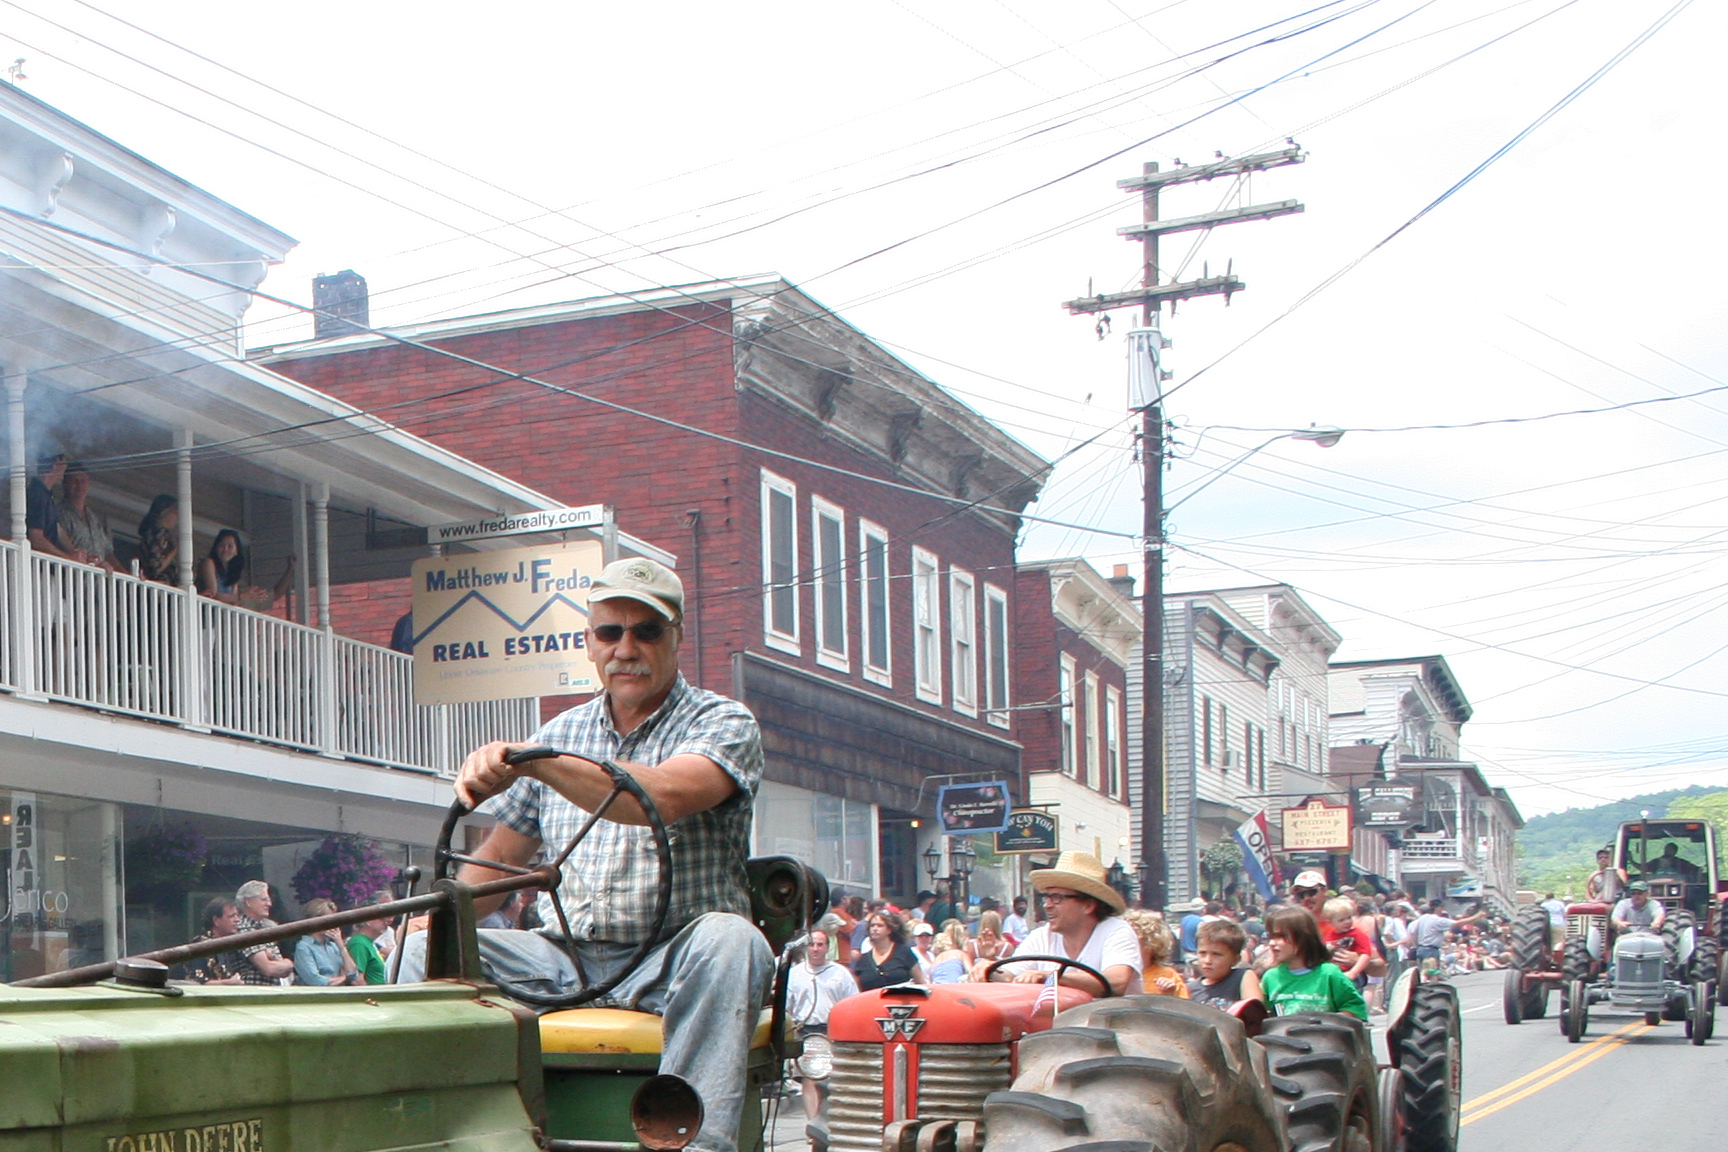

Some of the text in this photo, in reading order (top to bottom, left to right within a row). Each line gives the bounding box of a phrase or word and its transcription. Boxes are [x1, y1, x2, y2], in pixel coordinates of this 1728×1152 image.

[439, 509, 591, 538] www.fredarealty.com
[426, 558, 592, 593] Matthew J. Freda
[433, 631, 585, 662] REAL ESTATE
